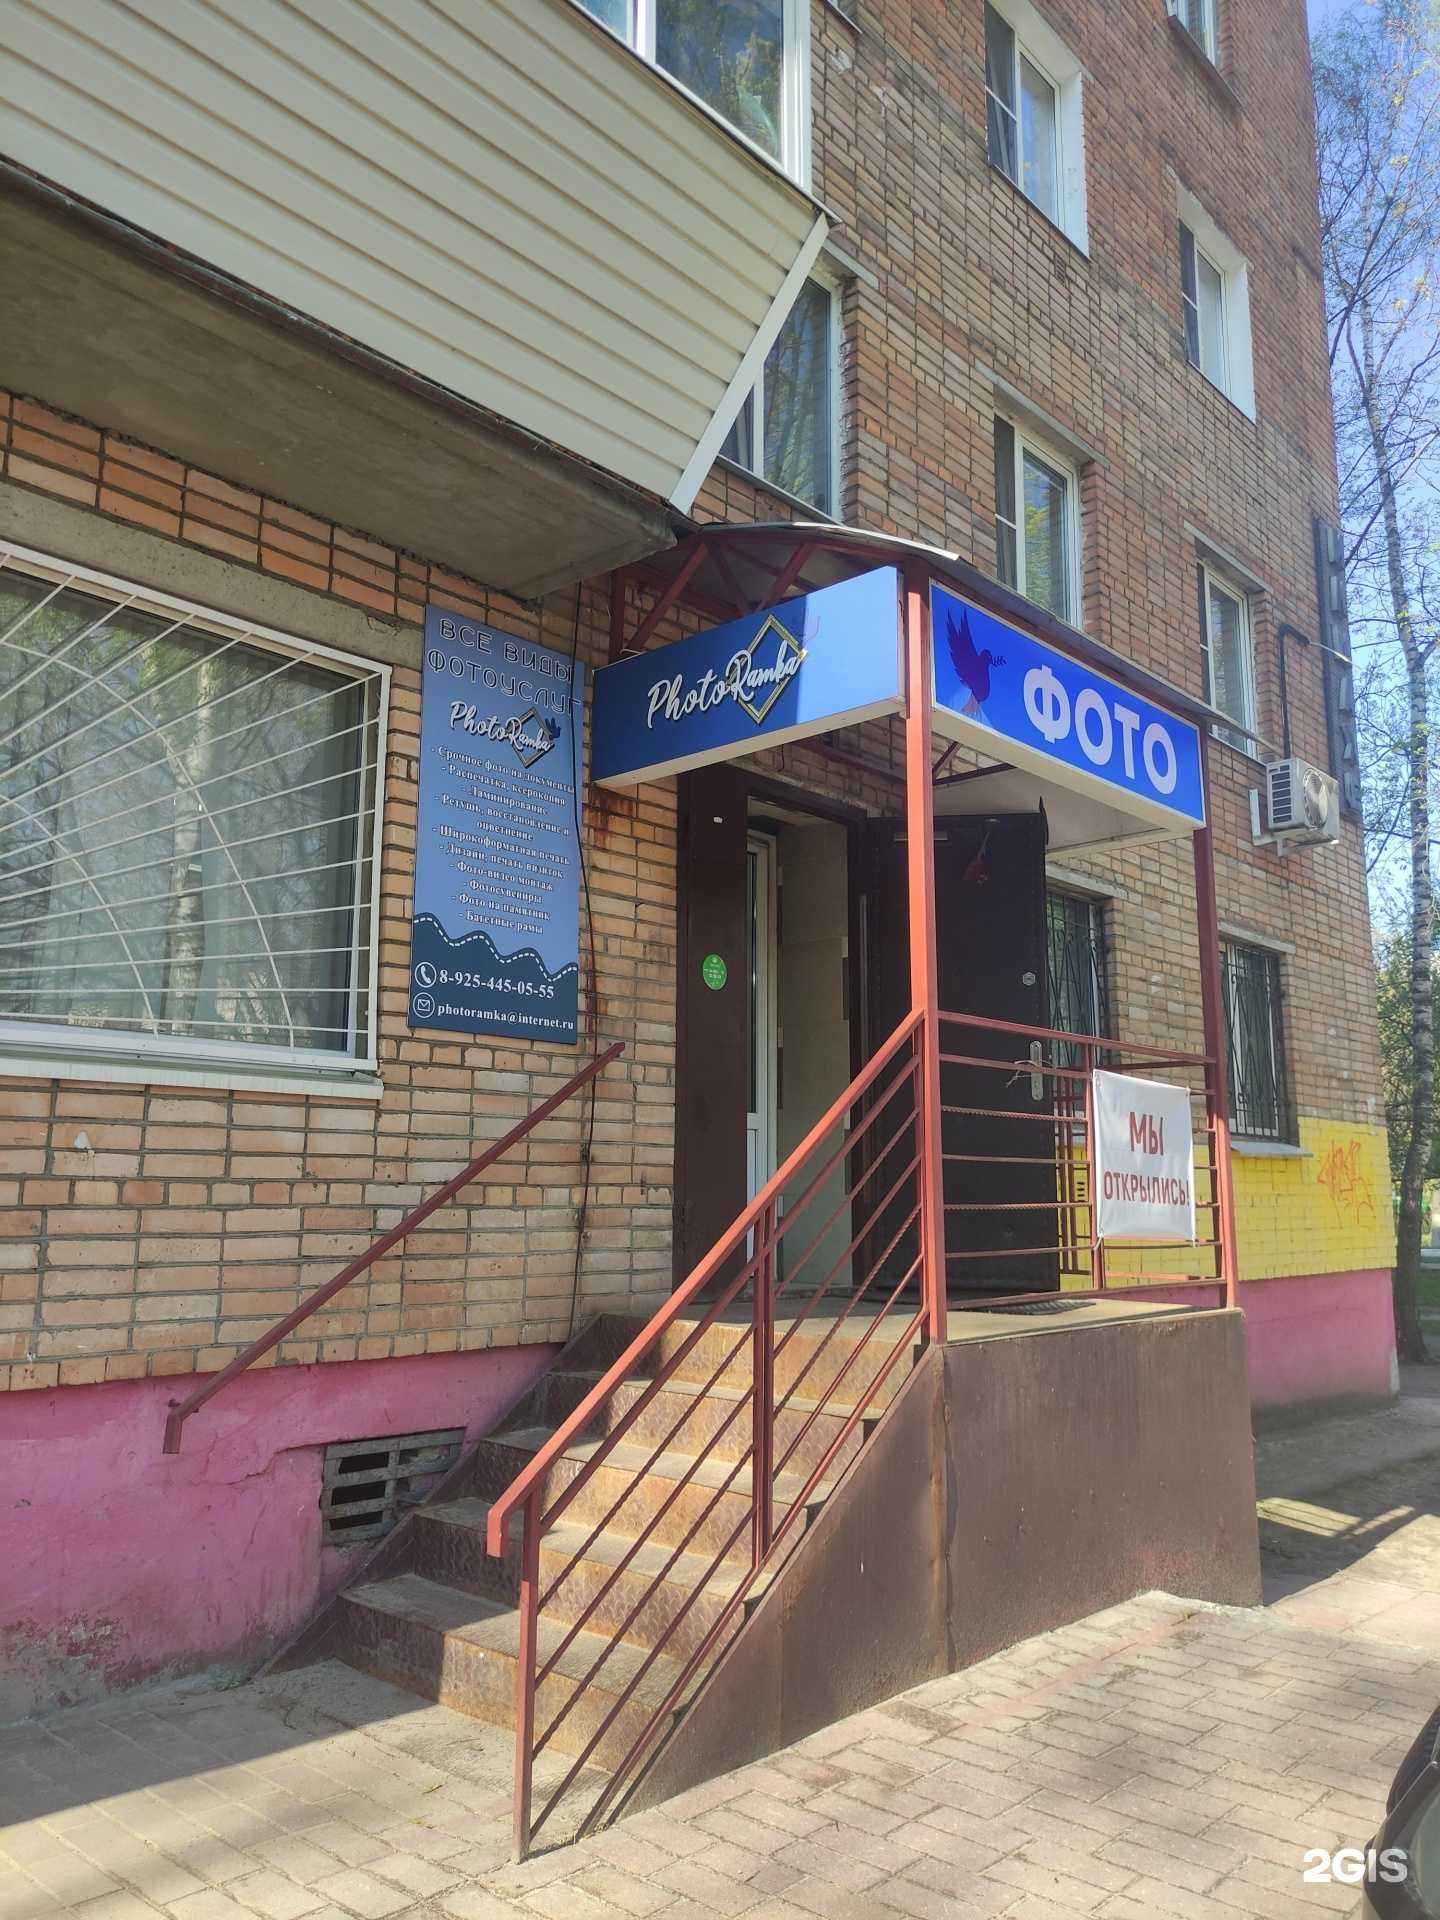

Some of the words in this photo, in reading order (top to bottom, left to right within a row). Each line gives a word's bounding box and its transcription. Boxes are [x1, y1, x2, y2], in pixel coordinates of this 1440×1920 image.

[439, 618, 493, 654] ВСЕ
[504, 642, 573, 684] ВИДЫ
[427, 649, 582, 715] ФОТОУСЛУГ
[1023, 664, 1177, 795] ФОТО
[438, 746, 482, 767] Срочное
[485, 760, 508, 774] фото
[511, 769, 522, 778] на
[523, 773, 574, 794] документы
[512, 784, 566, 805] ксерокопия
[487, 808, 560, 834] восстановление
[440, 825, 536, 857] Широкоформатная
[539, 851, 570, 866] печать
[457, 861, 515, 882] Фото-видео
[519, 876, 553, 892] монтаж
[491, 855, 523, 869] печать
[526, 863, 564, 878] визиток
[459, 893, 486, 907] Фото
[489, 900, 500, 911] на
[503, 904, 551, 920] памятник
[469, 879, 544, 904] Фотосувениры
[466, 910, 514, 927] Багетные
[517, 921, 544, 935] рамы
[439, 969, 555, 999] 8-925-445-05-55
[438, 1004, 574, 1030] photoramka@internet.ru
[1128, 1111, 1165, 1156] МЫ
[1103, 1171, 1190, 1207] ОТКРЫЛИСЬ!
